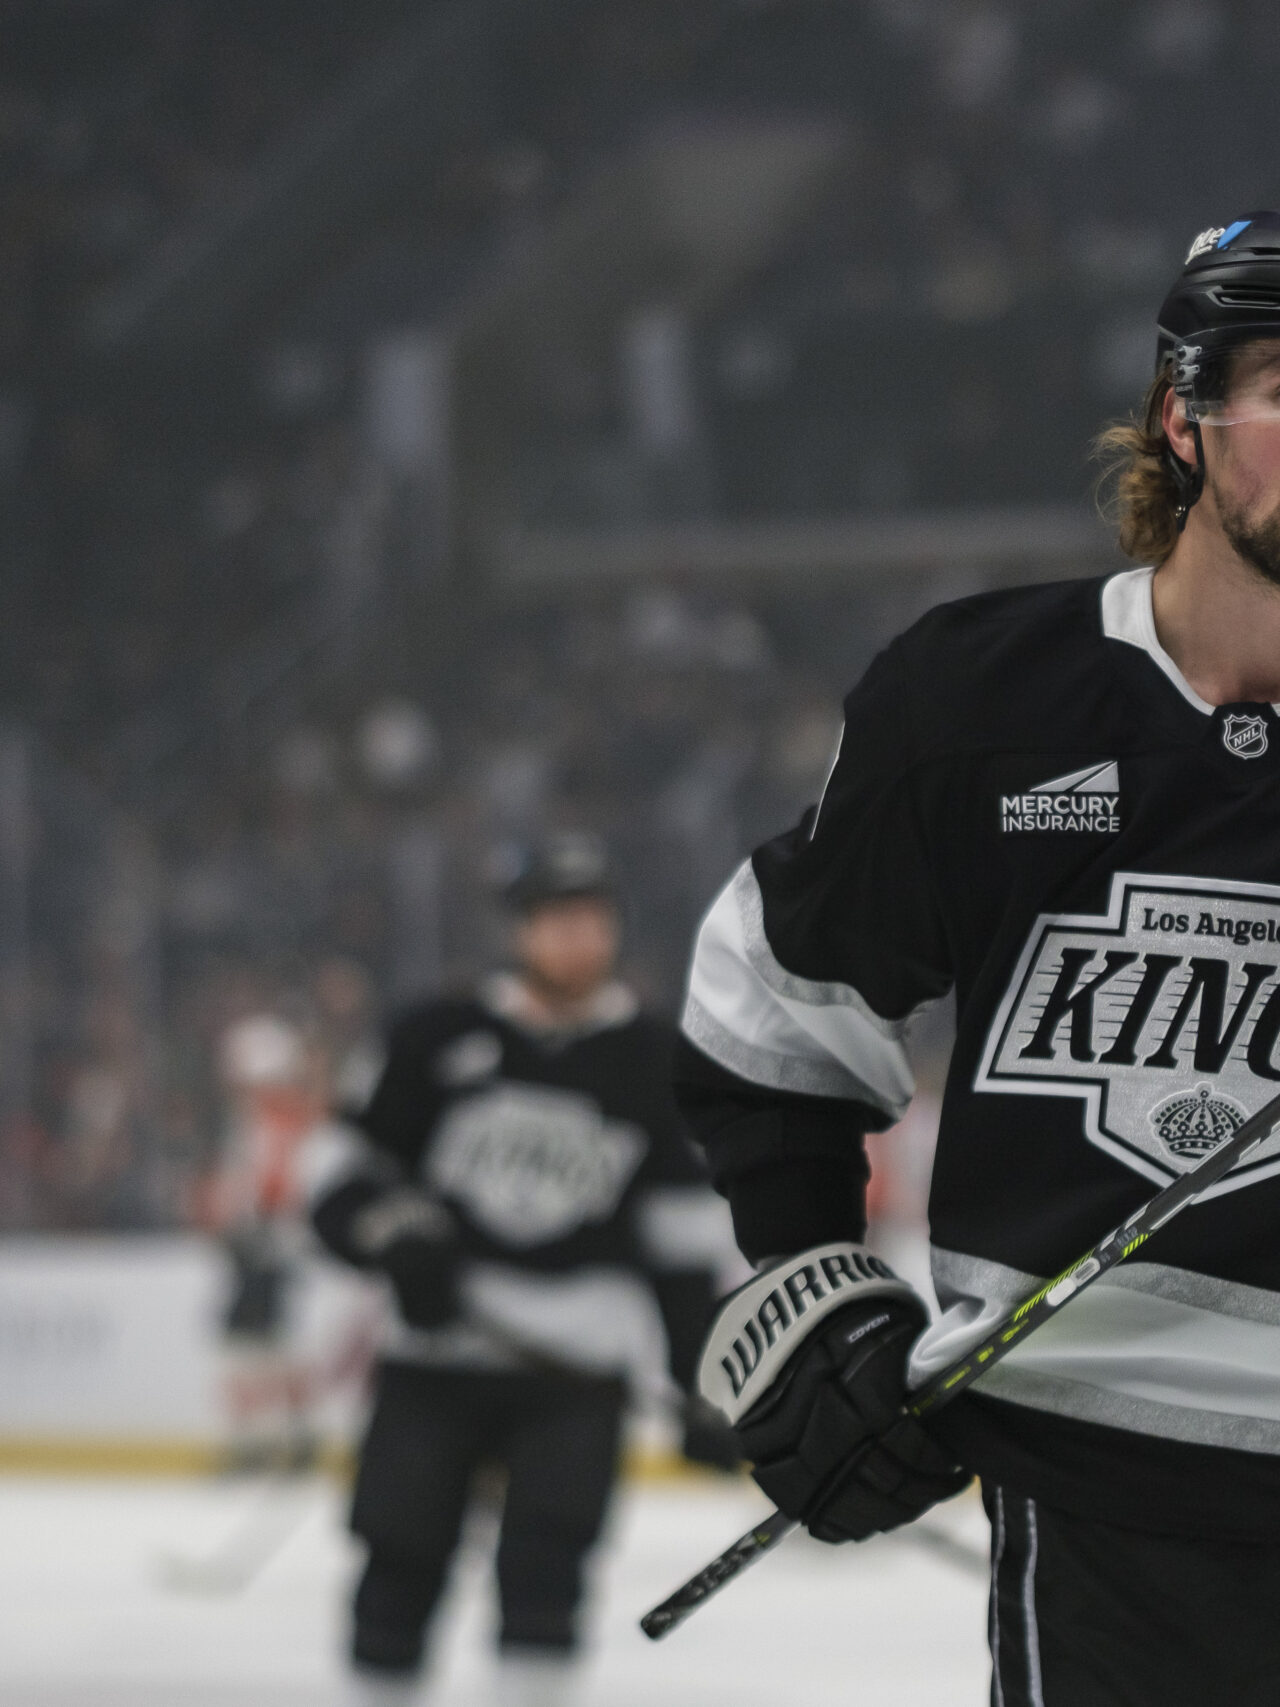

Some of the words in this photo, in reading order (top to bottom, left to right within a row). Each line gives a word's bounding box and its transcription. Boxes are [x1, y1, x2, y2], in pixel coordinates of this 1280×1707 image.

[1233, 727, 1260, 748] NHL
[1001, 795, 1120, 816] MERCURY
[1002, 814, 1121, 833] INSURANCE
[1141, 907, 1190, 934] Los
